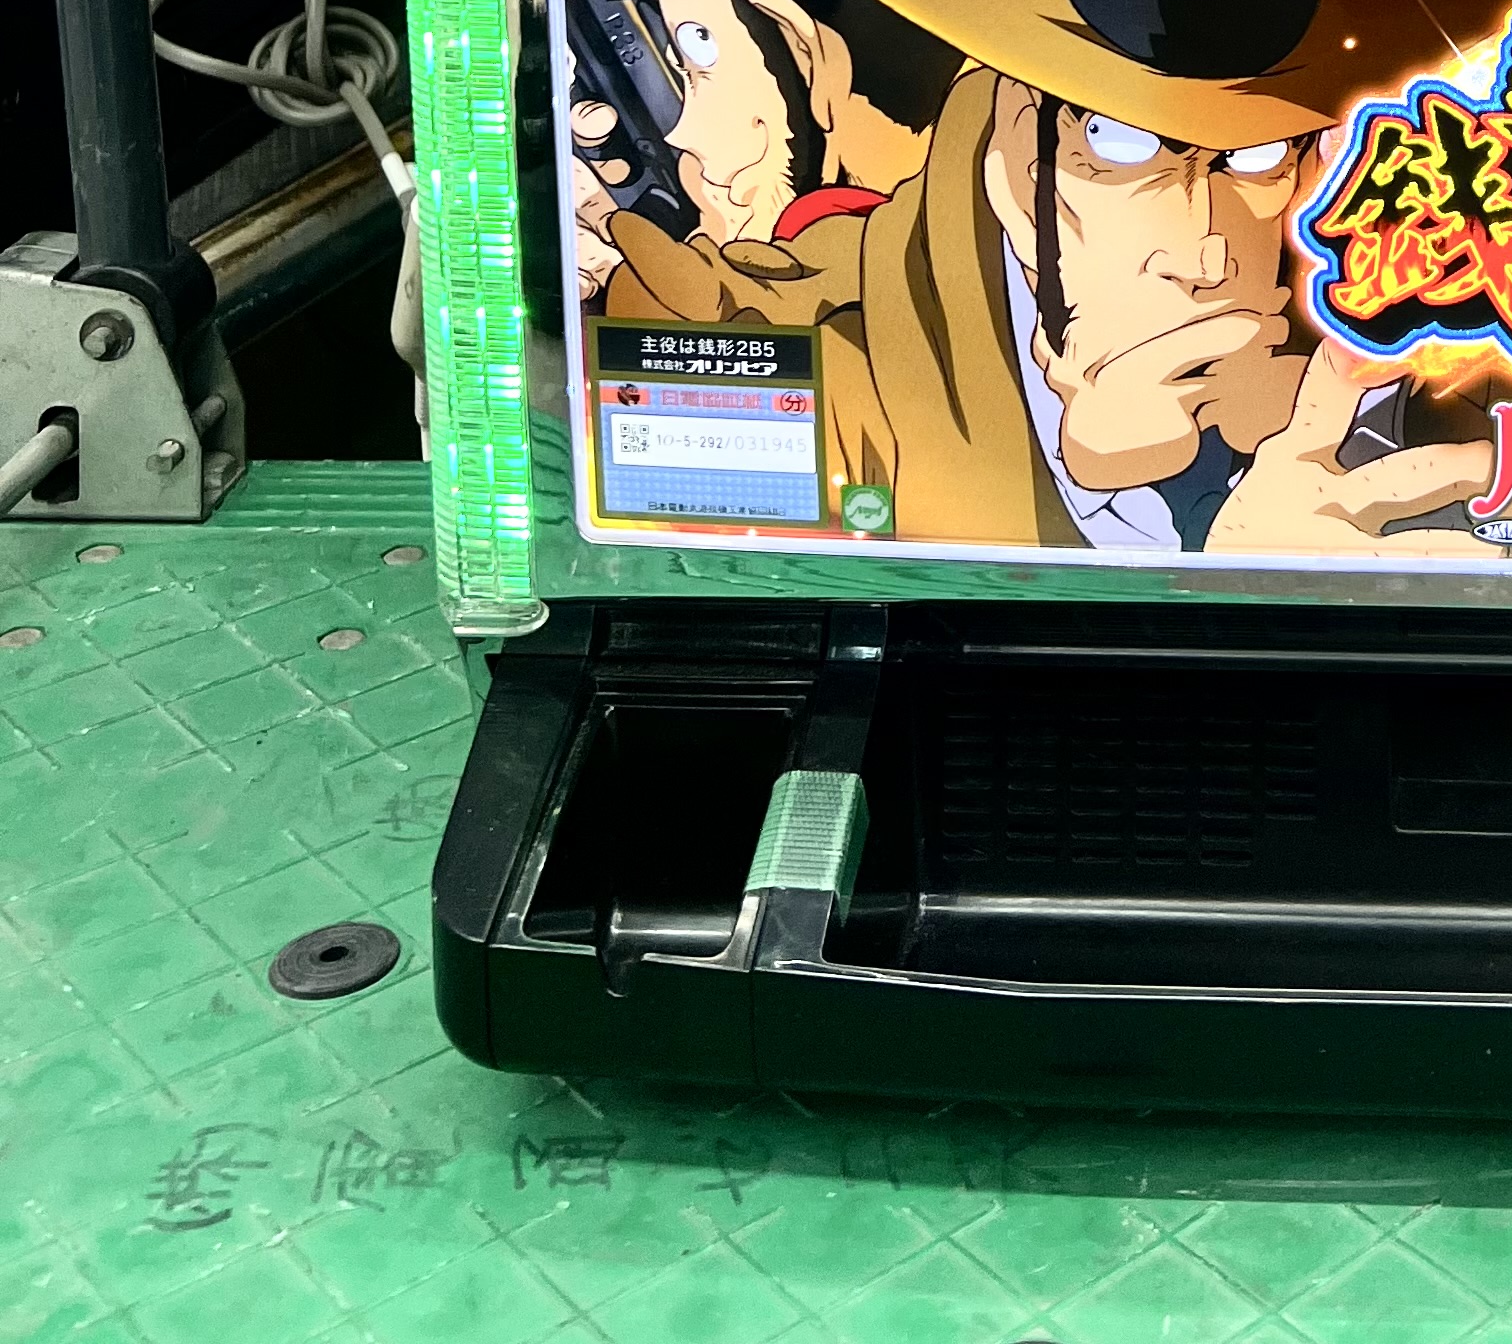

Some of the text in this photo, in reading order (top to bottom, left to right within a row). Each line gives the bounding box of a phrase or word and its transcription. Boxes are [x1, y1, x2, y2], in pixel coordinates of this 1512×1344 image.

[640, 335, 776, 358] 主役は銭形2B5
